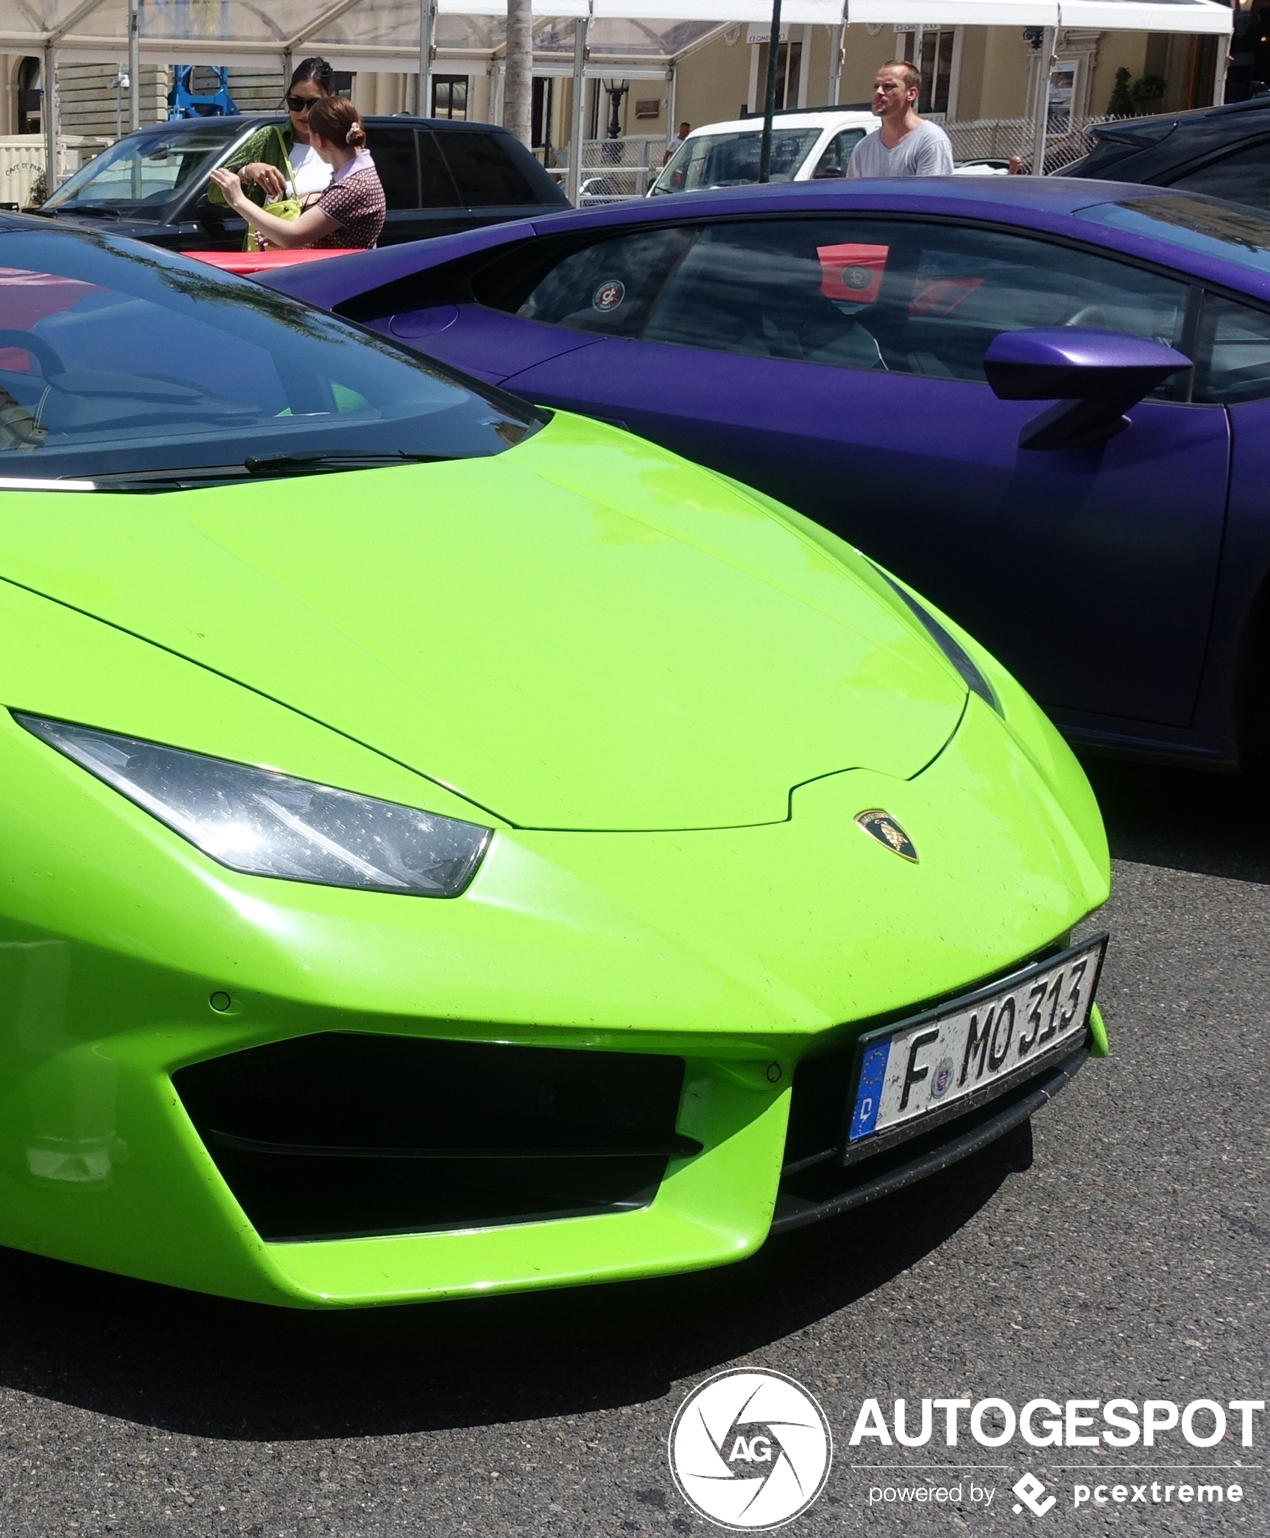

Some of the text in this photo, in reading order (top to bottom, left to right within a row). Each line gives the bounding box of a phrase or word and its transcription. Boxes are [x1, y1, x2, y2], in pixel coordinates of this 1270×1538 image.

[898, 956, 1089, 1113] F MO 313
